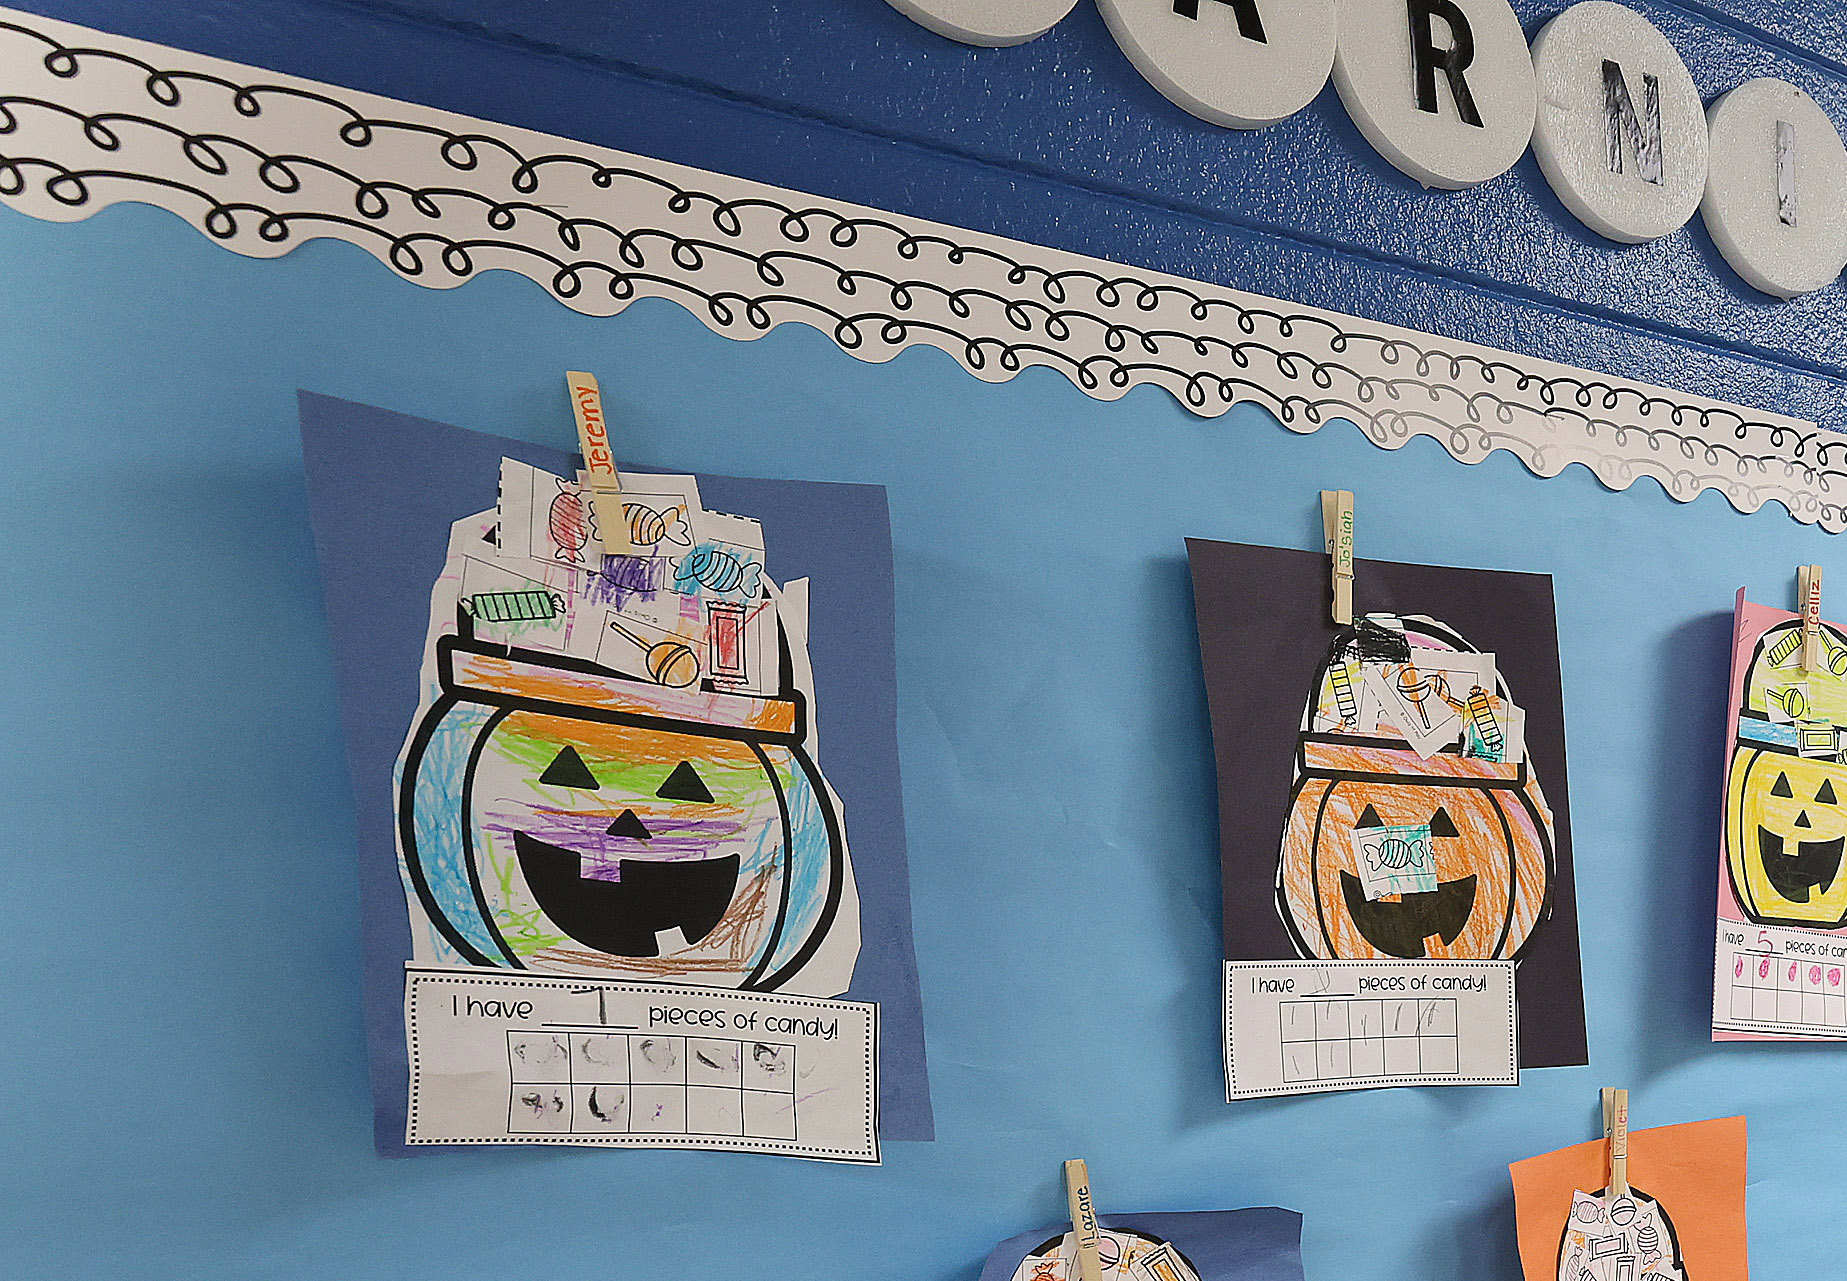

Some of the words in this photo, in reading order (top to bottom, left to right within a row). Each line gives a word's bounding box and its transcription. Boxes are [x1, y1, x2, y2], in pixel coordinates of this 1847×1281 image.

[576, 386, 612, 475] Jeremy
[1725, 929, 1745, 946] have
[1757, 930, 1774, 957] 5
[1785, 939, 1816, 955] pieces
[1818, 942, 1830, 956] of
[1258, 976, 1296, 994] have
[1358, 975, 1406, 995] pieces
[1410, 974, 1430, 990] of
[1432, 974, 1488, 994] candy!
[465, 994, 534, 1020] have
[648, 1003, 726, 1028] pieces
[732, 1010, 760, 1033] of
[763, 1013, 839, 1041] candy!
[1077, 1185, 1095, 1241] Lazare
